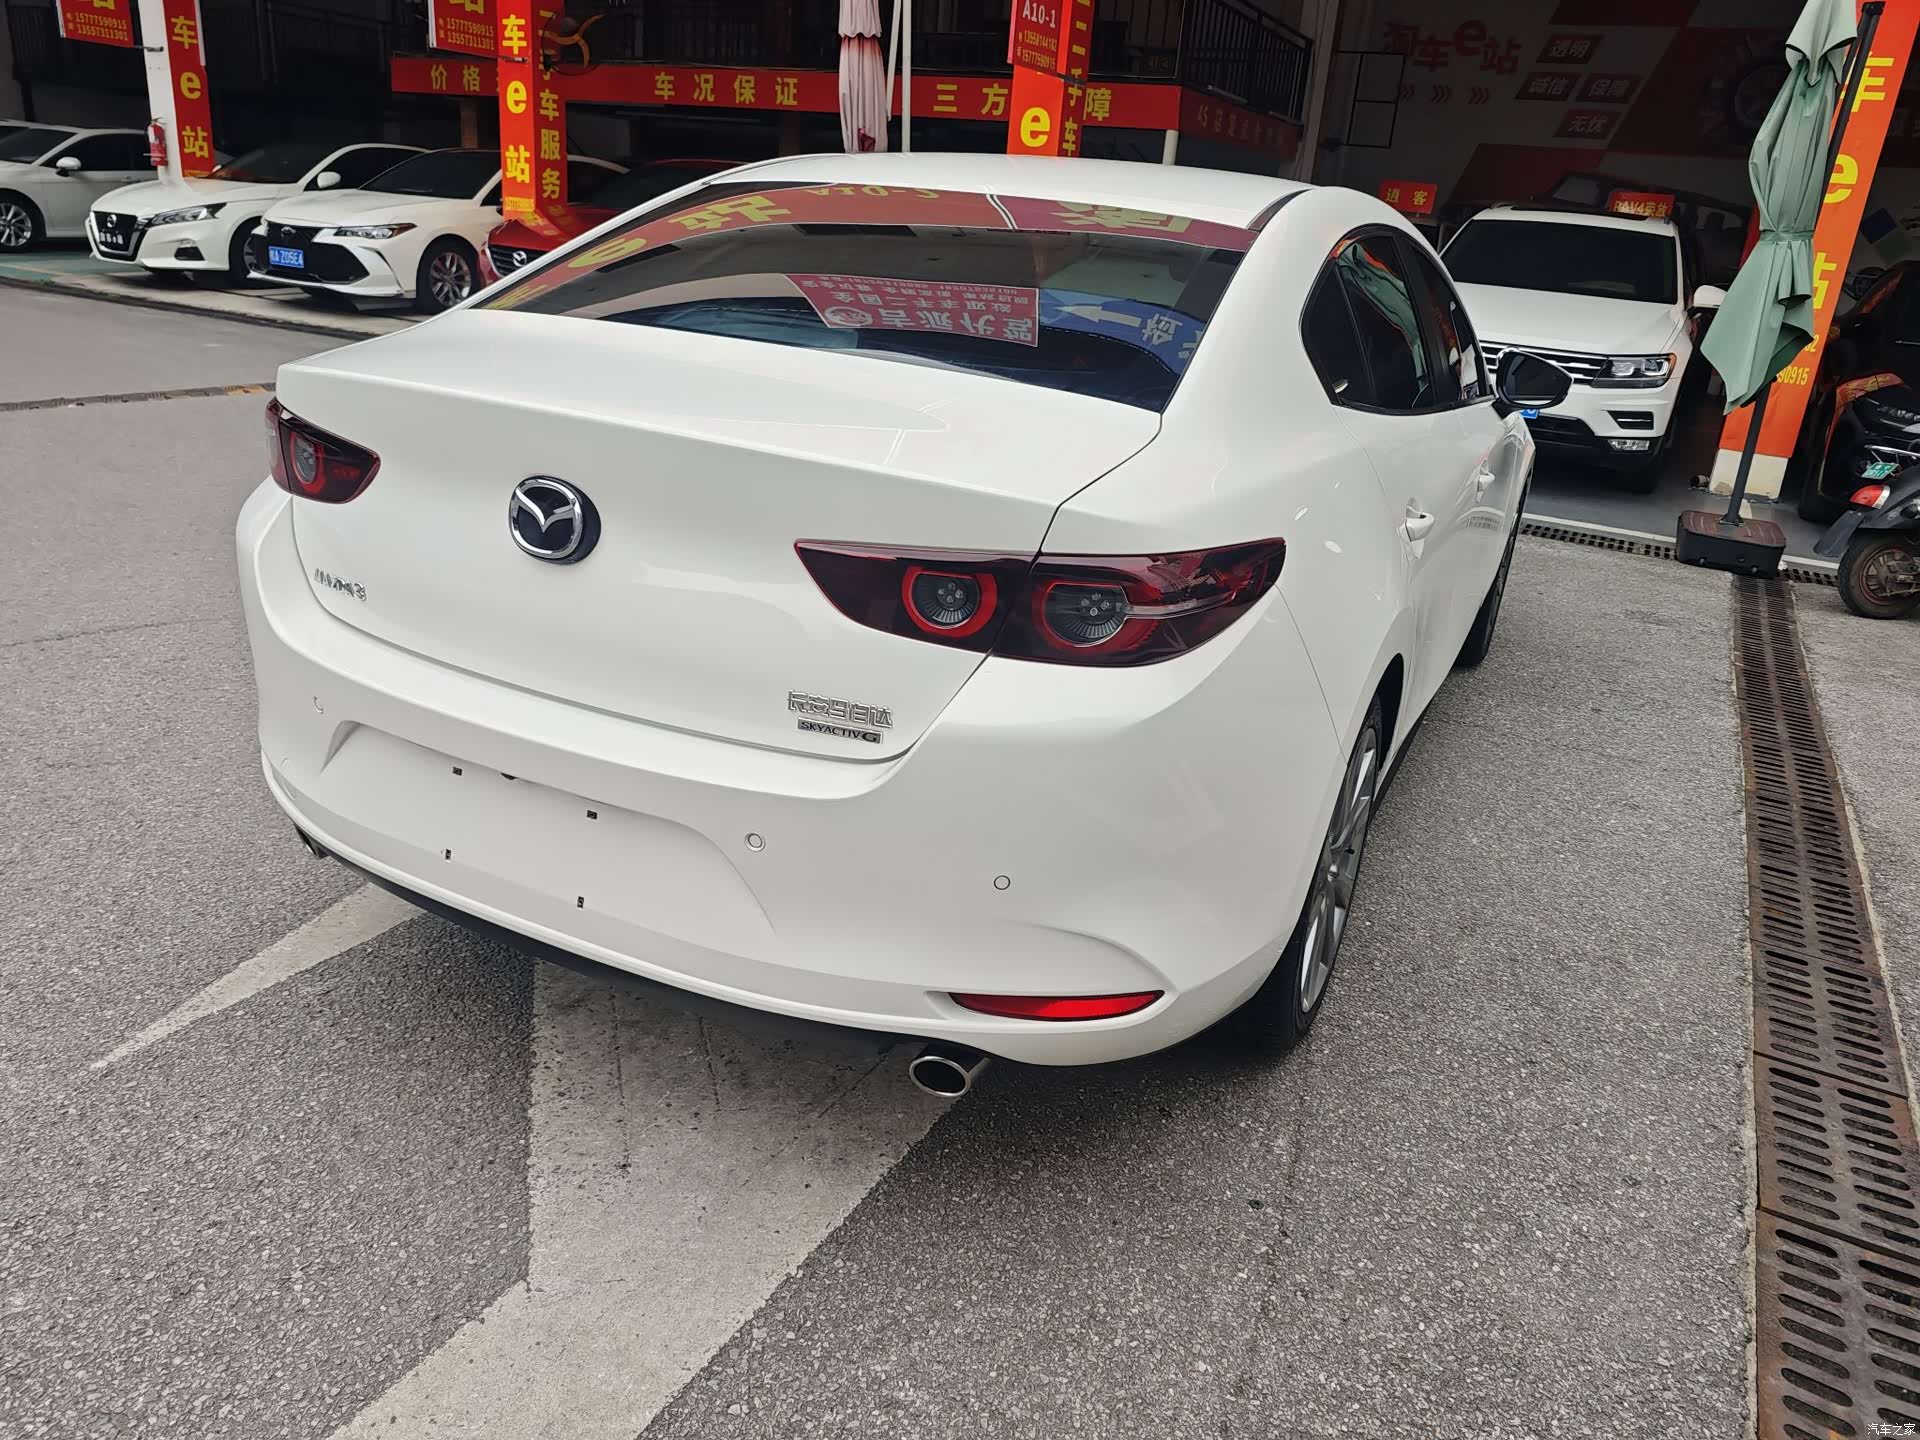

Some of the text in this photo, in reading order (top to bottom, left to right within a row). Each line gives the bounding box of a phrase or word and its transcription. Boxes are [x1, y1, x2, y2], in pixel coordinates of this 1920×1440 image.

[75, 12, 127, 29] 15777590915
[1022, 0, 1056, 28] A10-1
[446, 18, 494, 36] 15777590915
[431, 64, 499, 91] 价格
[654, 72, 798, 106] 车况保证
